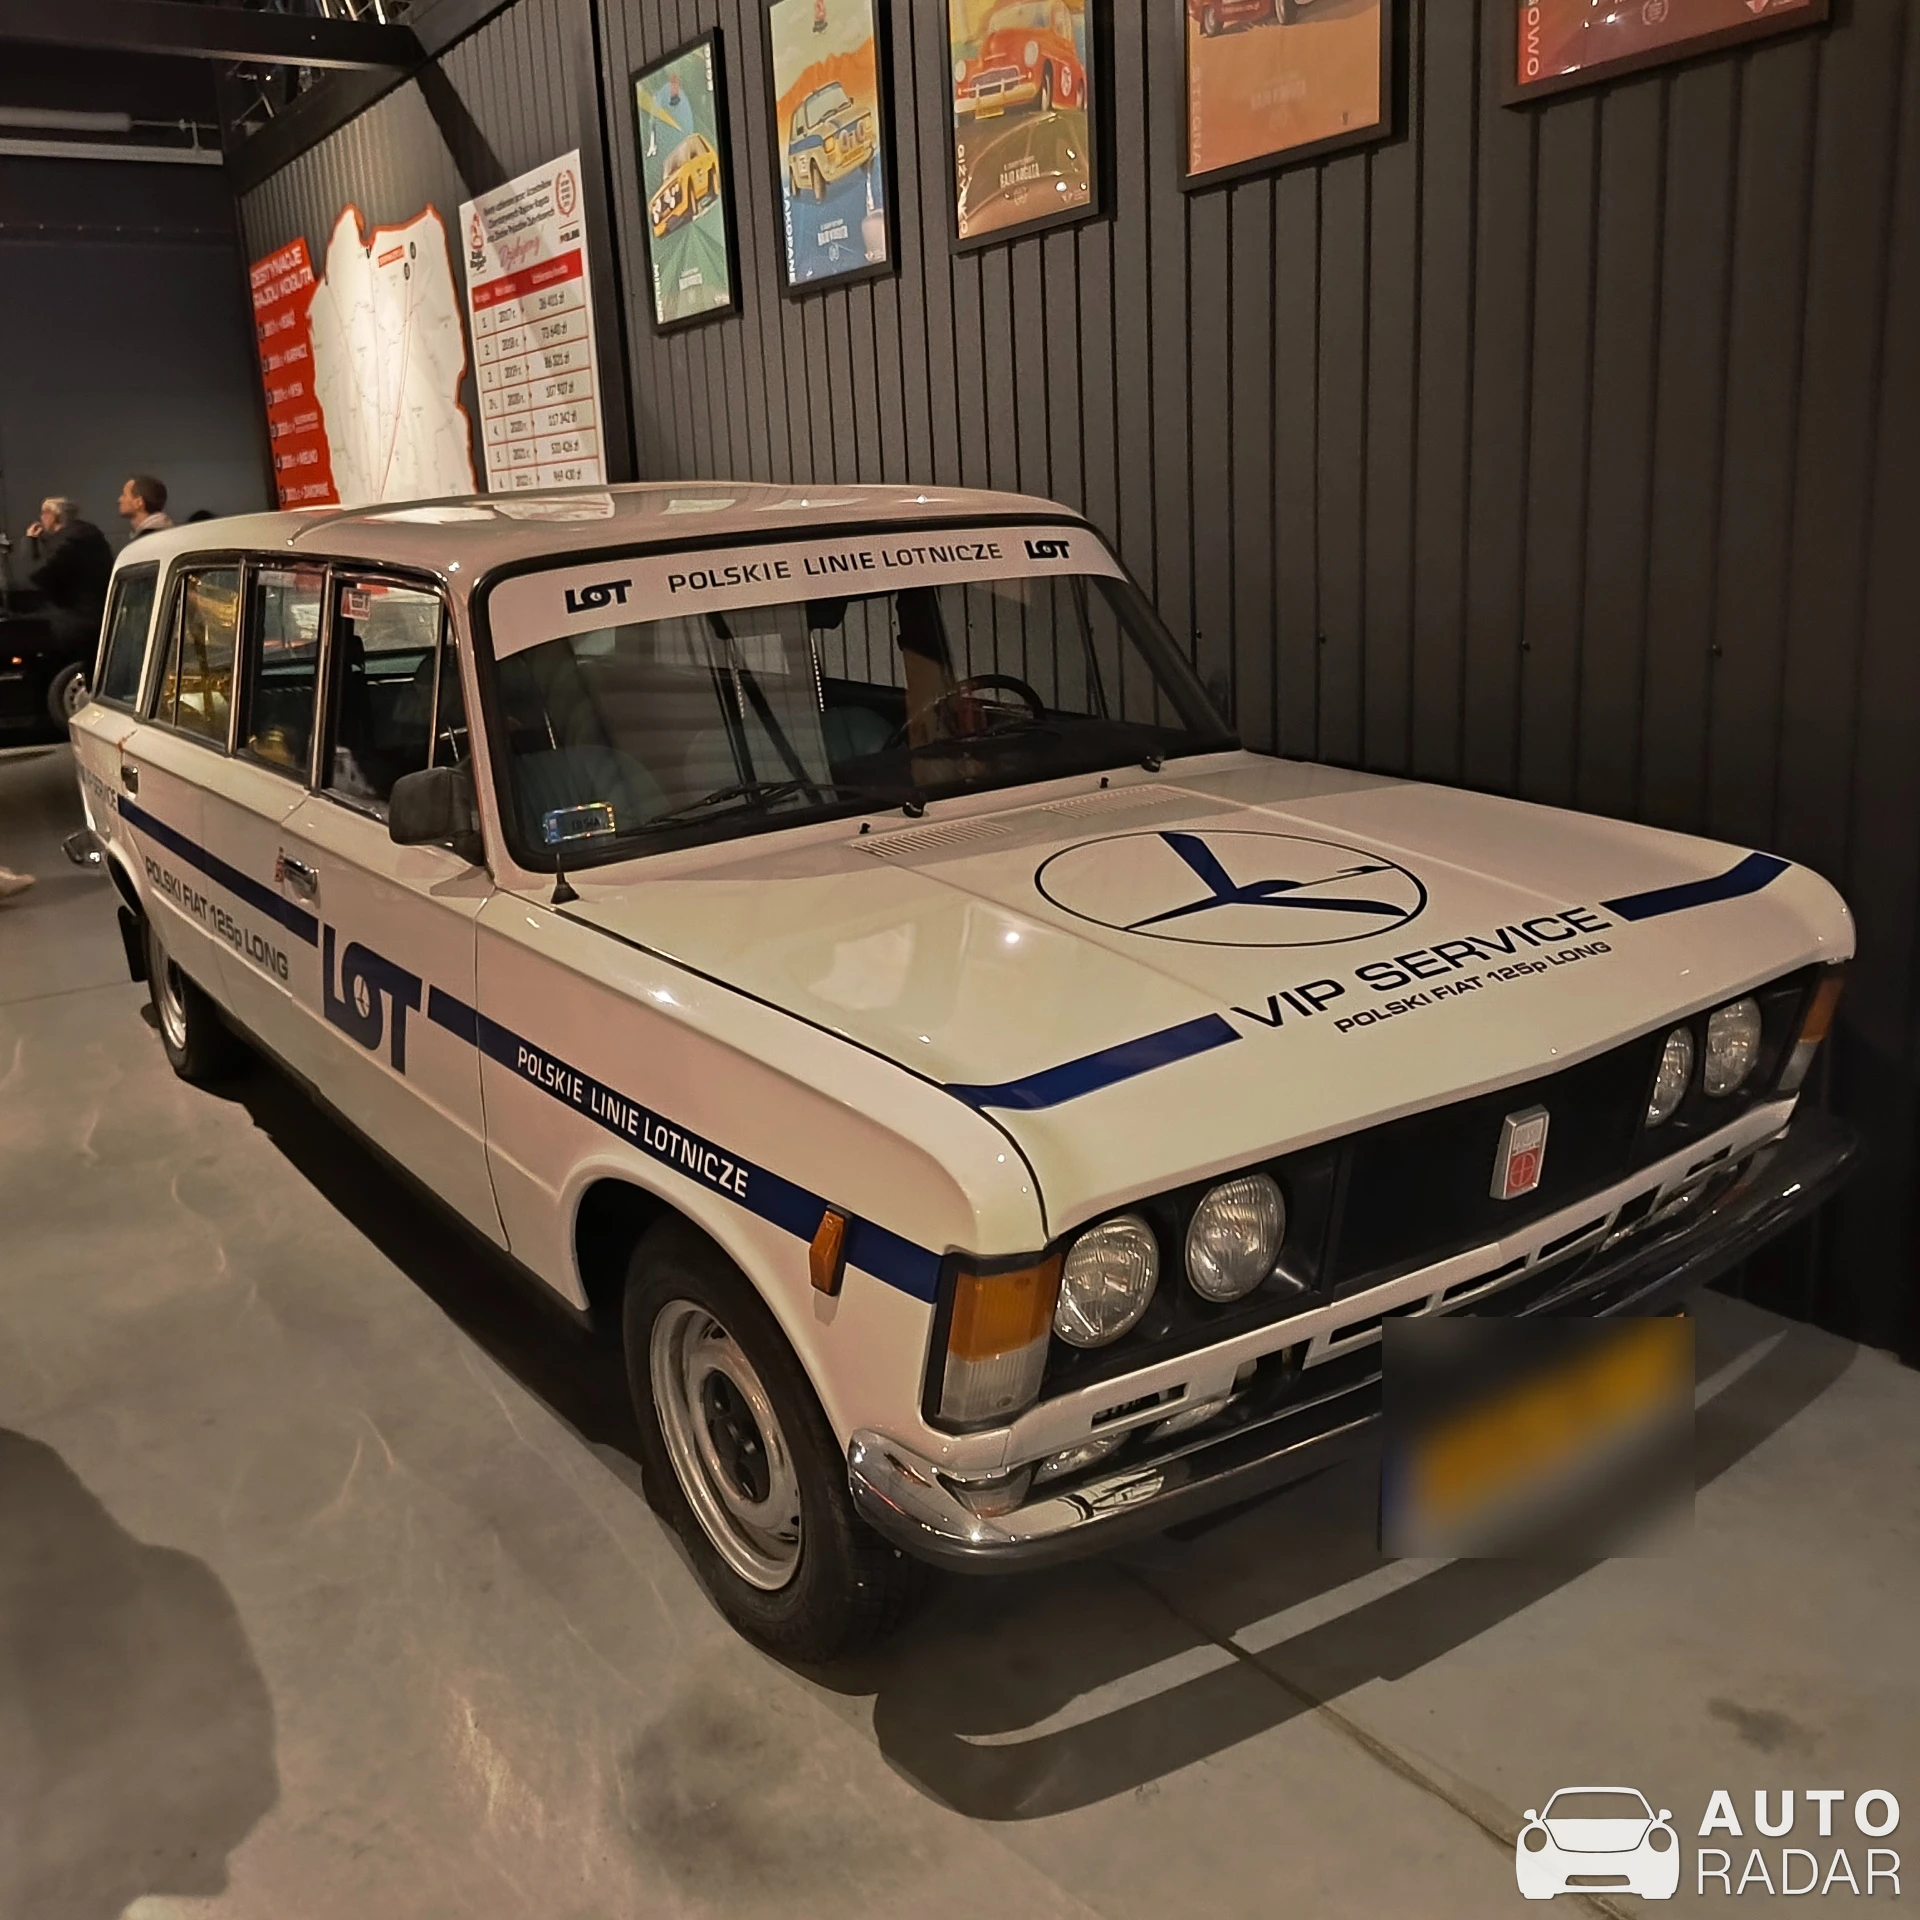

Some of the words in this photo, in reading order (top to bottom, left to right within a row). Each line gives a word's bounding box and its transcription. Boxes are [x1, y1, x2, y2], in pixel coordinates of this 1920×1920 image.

[564, 579, 633, 614] LOT
[668, 560, 792, 593] POLSKIE
[803, 552, 876, 576] LINIE
[881, 542, 1004, 568] LOTNICZE
[1024, 539, 1071, 560] LOT
[145, 856, 182, 901] POLSKI
[183, 885, 207, 921] FIAT
[210, 904, 243, 951] 125p
[245, 929, 289, 981] LONG
[1230, 978, 1346, 1028] VIP
[1354, 907, 1613, 992] SERVICE
[323, 922, 423, 1077] LOT
[1333, 991, 1433, 1034] POLSKI
[1431, 976, 1484, 1001] FIAT
[1487, 960, 1549, 983] 125p
[1543, 941, 1612, 967] LONG
[517, 1046, 584, 1104] POLSKIE
[591, 1087, 640, 1137] LINIE
[643, 1117, 749, 1199] LOTNICZE
